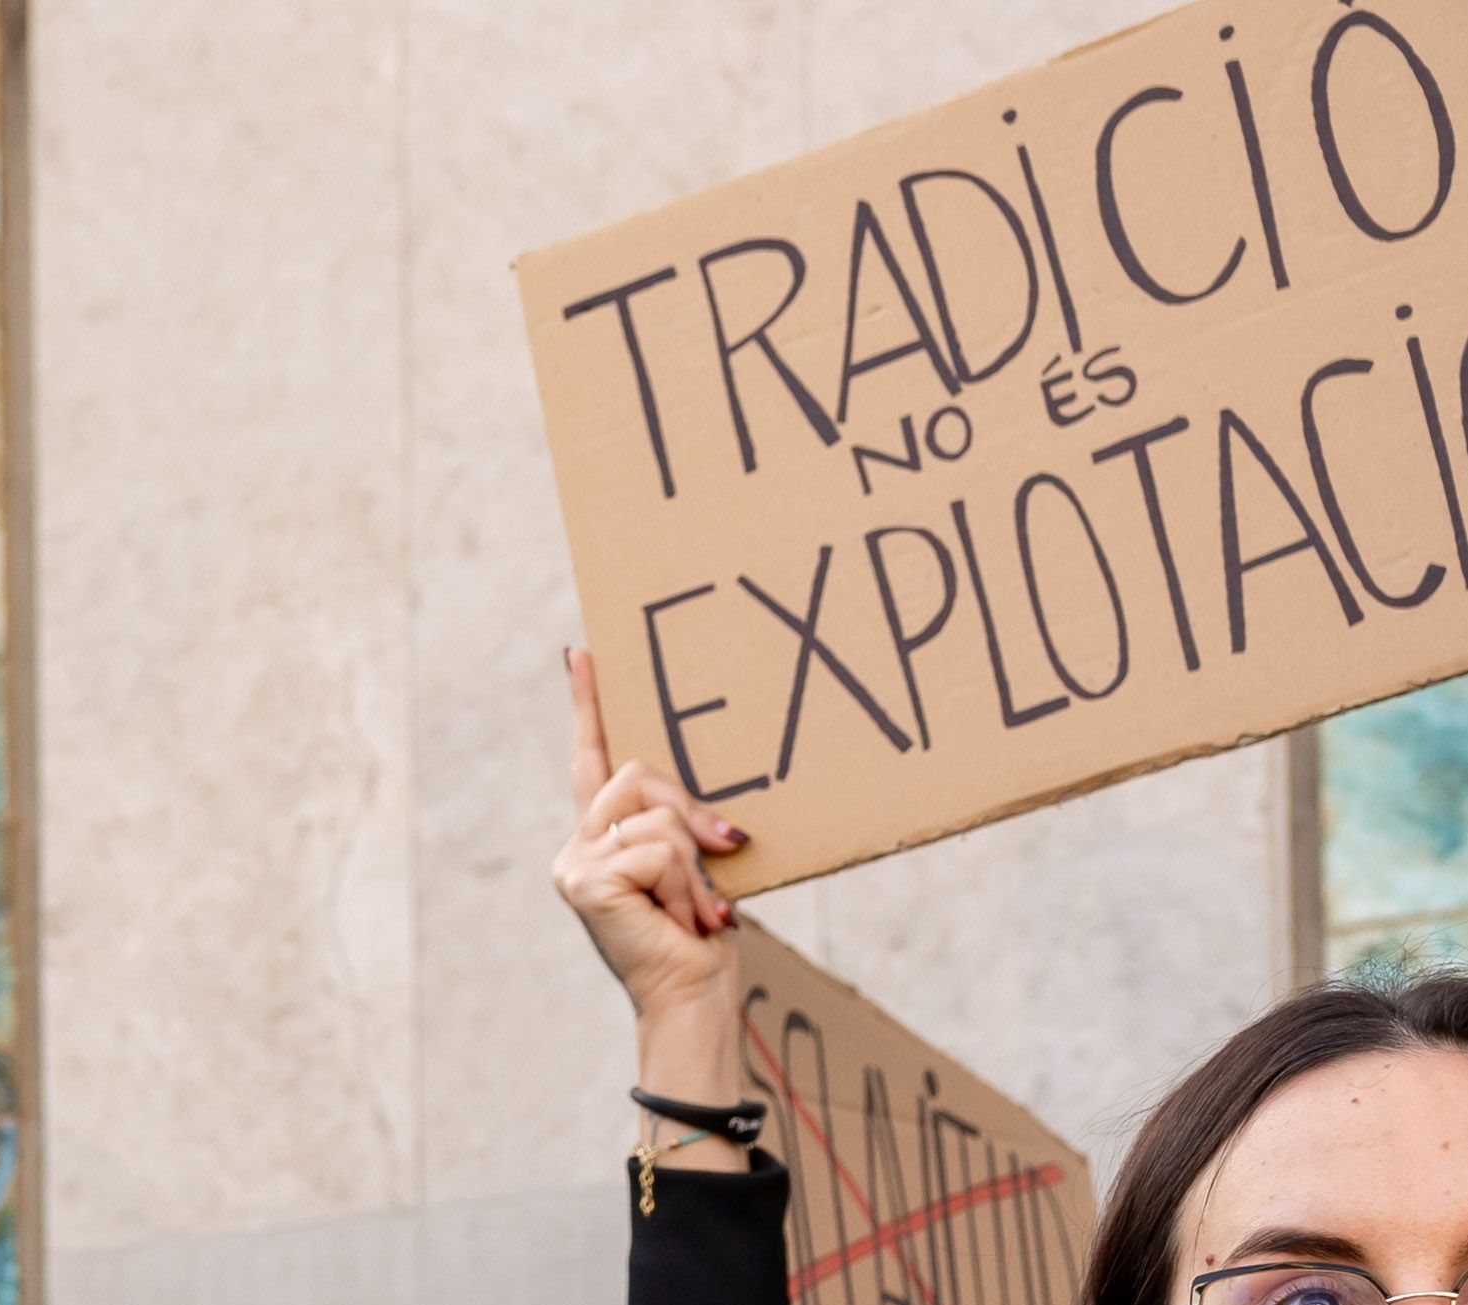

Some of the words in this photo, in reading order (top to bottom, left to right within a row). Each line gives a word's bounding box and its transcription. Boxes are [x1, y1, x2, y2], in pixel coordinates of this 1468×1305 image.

[643, 303, 1468, 803] EXPLOTACi
[850, 405, 974, 496] NO
[1040, 345, 1138, 428] ÉS
